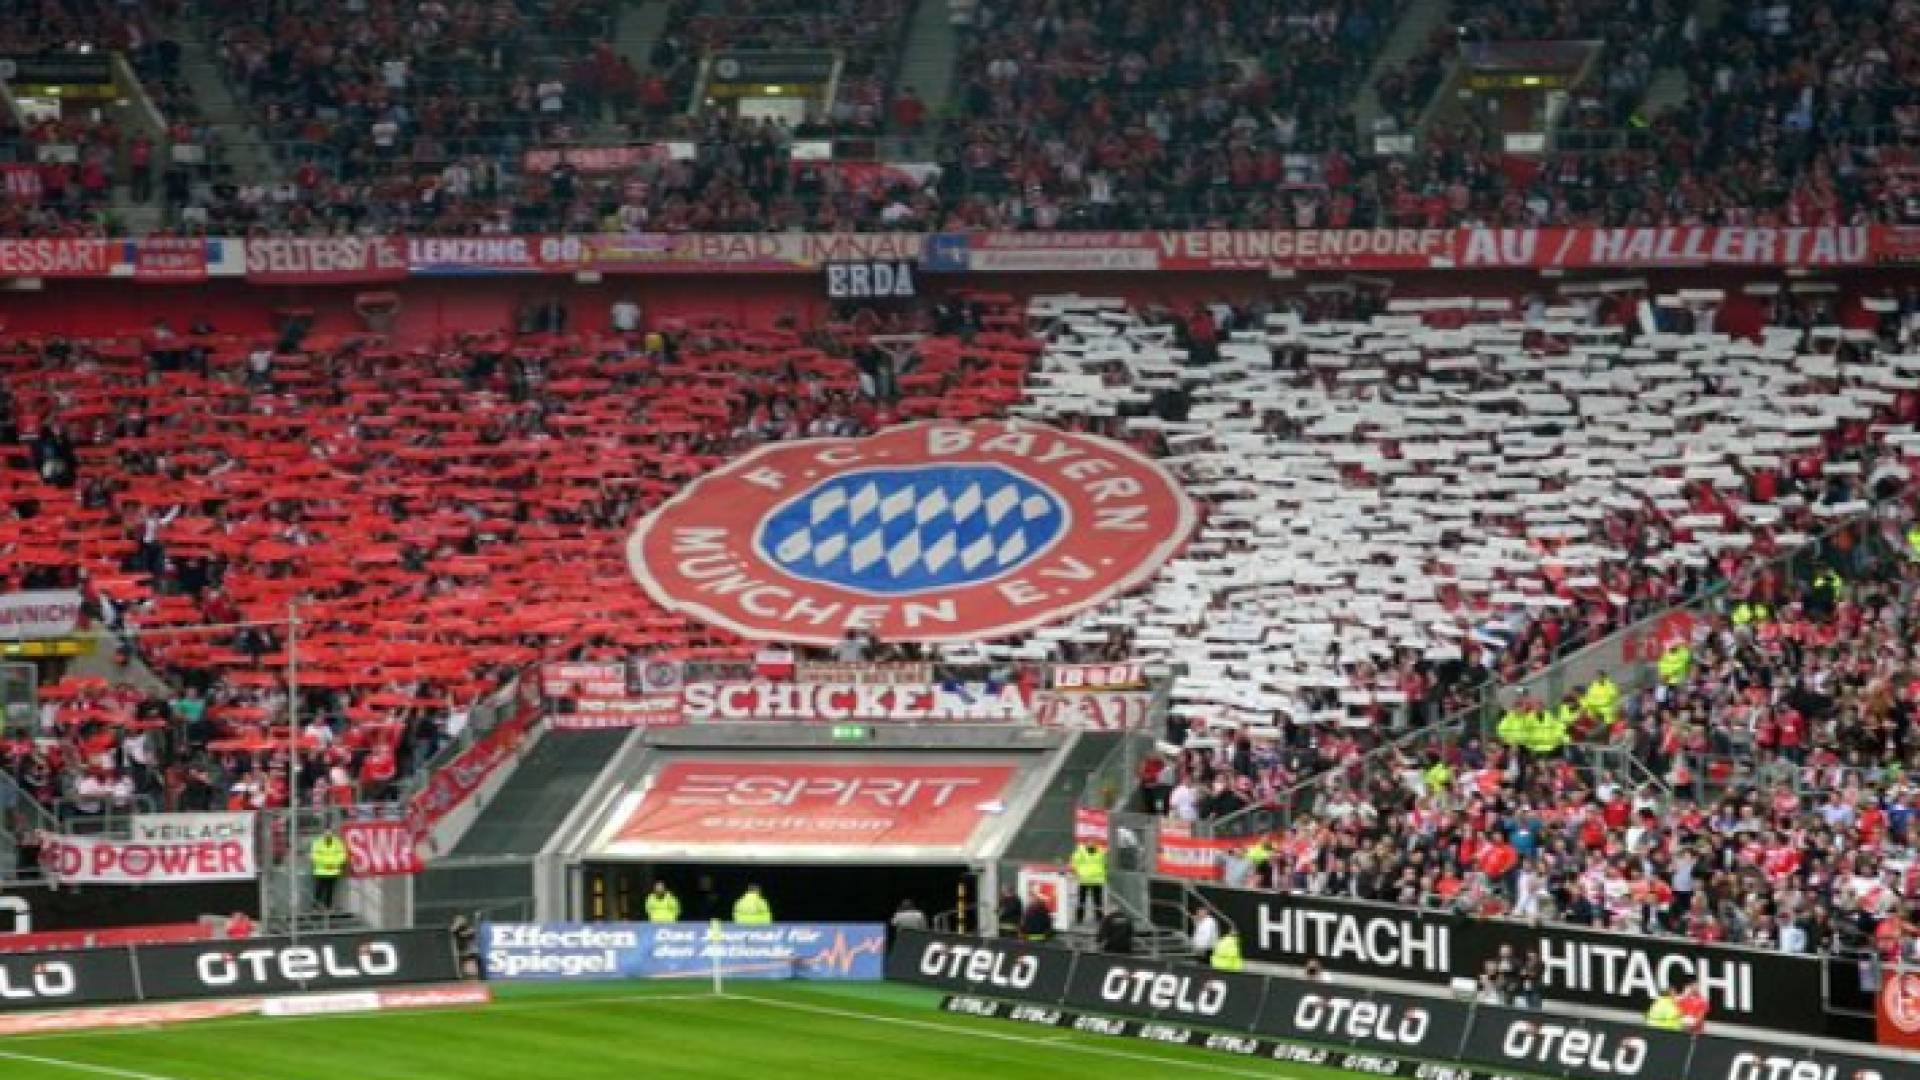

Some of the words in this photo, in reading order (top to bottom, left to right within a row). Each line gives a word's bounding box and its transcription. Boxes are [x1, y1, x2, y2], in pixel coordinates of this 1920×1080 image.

[1463, 224, 1535, 264] AU
[1590, 227, 1869, 264] HALLERTAU
[928, 428, 1149, 532] BAYERN
[671, 526, 958, 630] MÜNCHEN
[668, 773, 981, 807] ESPRIT
[700, 815, 894, 832] esprit.com
[91, 840, 247, 876] POWER
[489, 925, 638, 948] Effecten
[1258, 903, 1451, 973] HITACHI
[487, 949, 617, 976] Spiegel
[1540, 938, 1753, 1013] HITACHI
